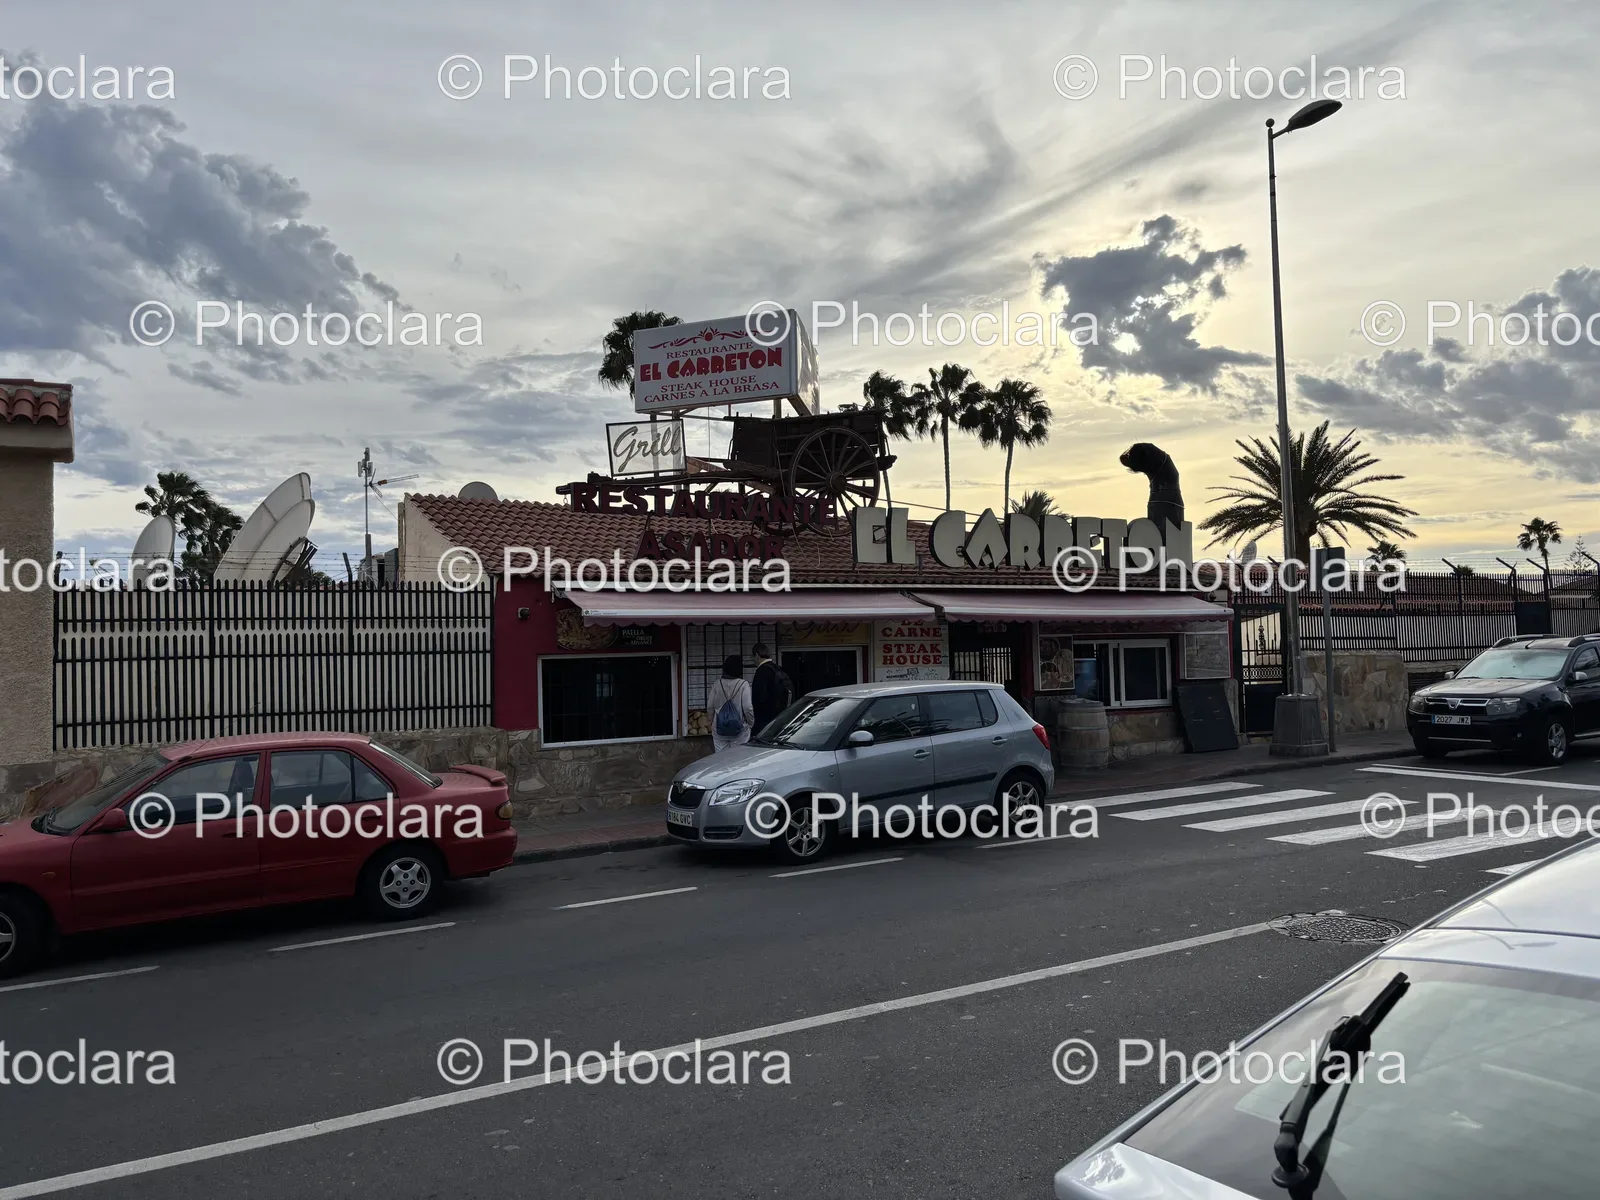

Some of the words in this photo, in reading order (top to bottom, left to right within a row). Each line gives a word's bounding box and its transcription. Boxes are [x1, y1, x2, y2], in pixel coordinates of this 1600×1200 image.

[666, 341, 754, 360] RESTAURANTE
[640, 363, 661, 382] EL
[667, 347, 782, 379] CARRETON
[644, 390, 696, 403] CARNES
[700, 389, 709, 397] A
[713, 387, 730, 396] LA
[733, 381, 780, 393] BRASA
[660, 381, 703, 393] STEAK
[709, 375, 757, 388] HOUSE
[613, 425, 682, 472] Grill
[570, 482, 838, 525] RESTAURANTE
[635, 530, 785, 562] ASADOR
[852, 507, 916, 565] EL
[929, 508, 1193, 573] CARRETON
[881, 627, 942, 637] CARNE
[882, 643, 942, 653] STEAK
[882, 654, 943, 665] HOUSE
